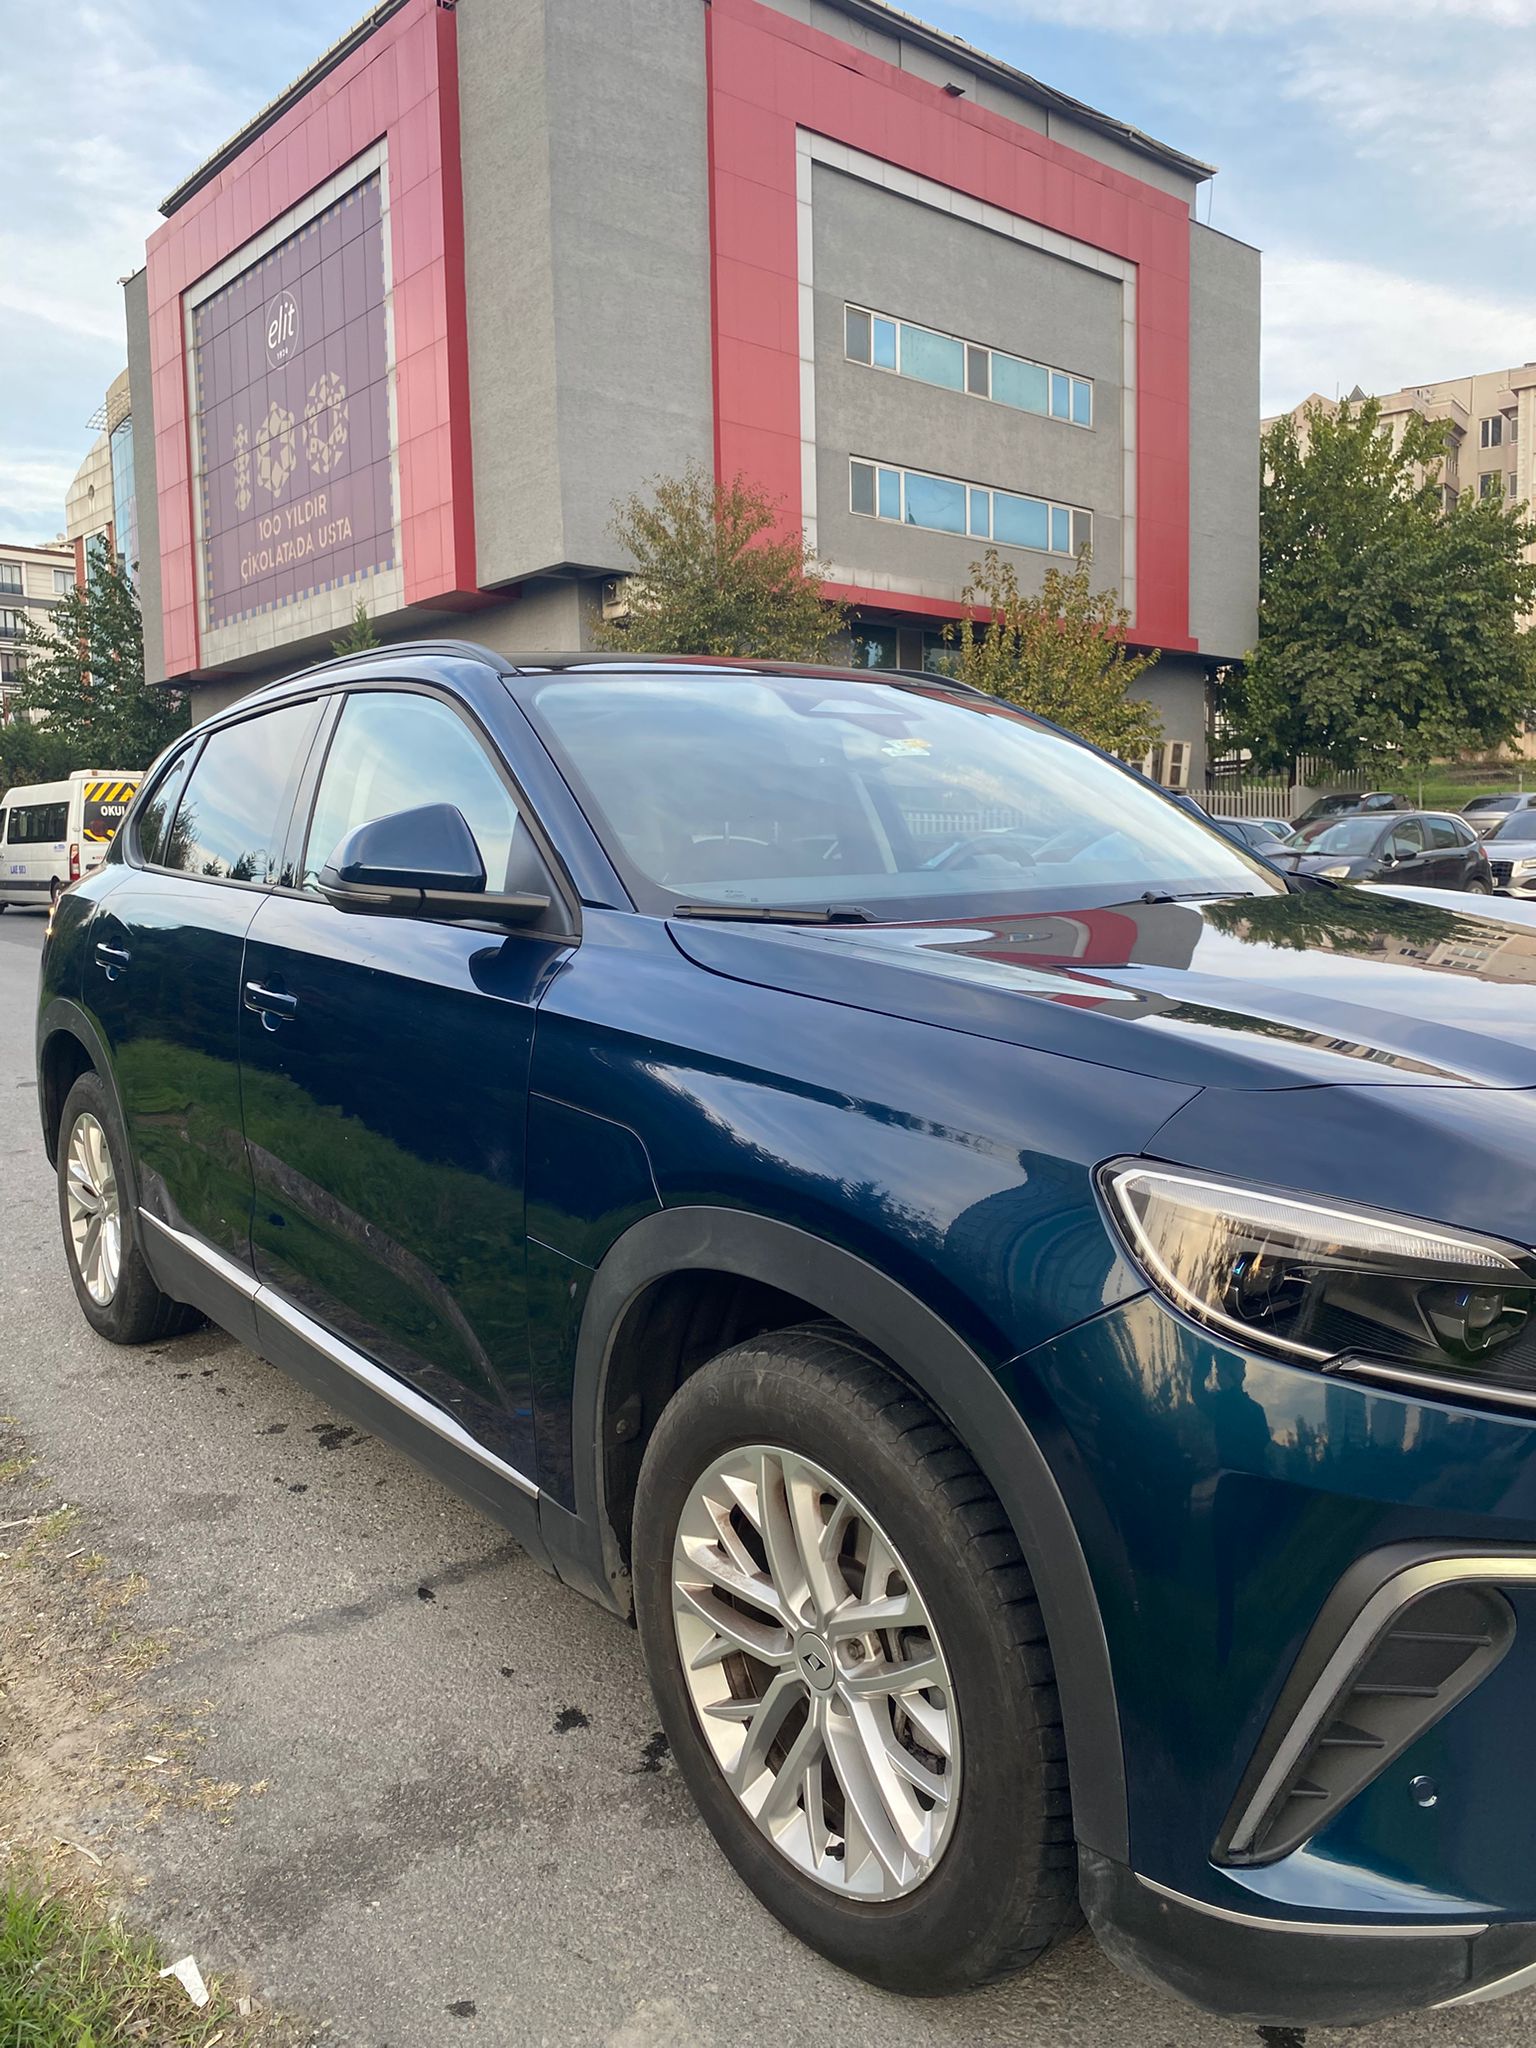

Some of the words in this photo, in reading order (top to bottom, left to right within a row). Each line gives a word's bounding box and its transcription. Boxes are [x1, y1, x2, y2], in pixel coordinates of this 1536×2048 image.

[268, 302, 295, 349] elit
[259, 515, 282, 541] 100
[285, 494, 327, 530] YILDIR
[240, 532, 315, 585] ÇİKOLATADA
[318, 516, 352, 549] USTA
